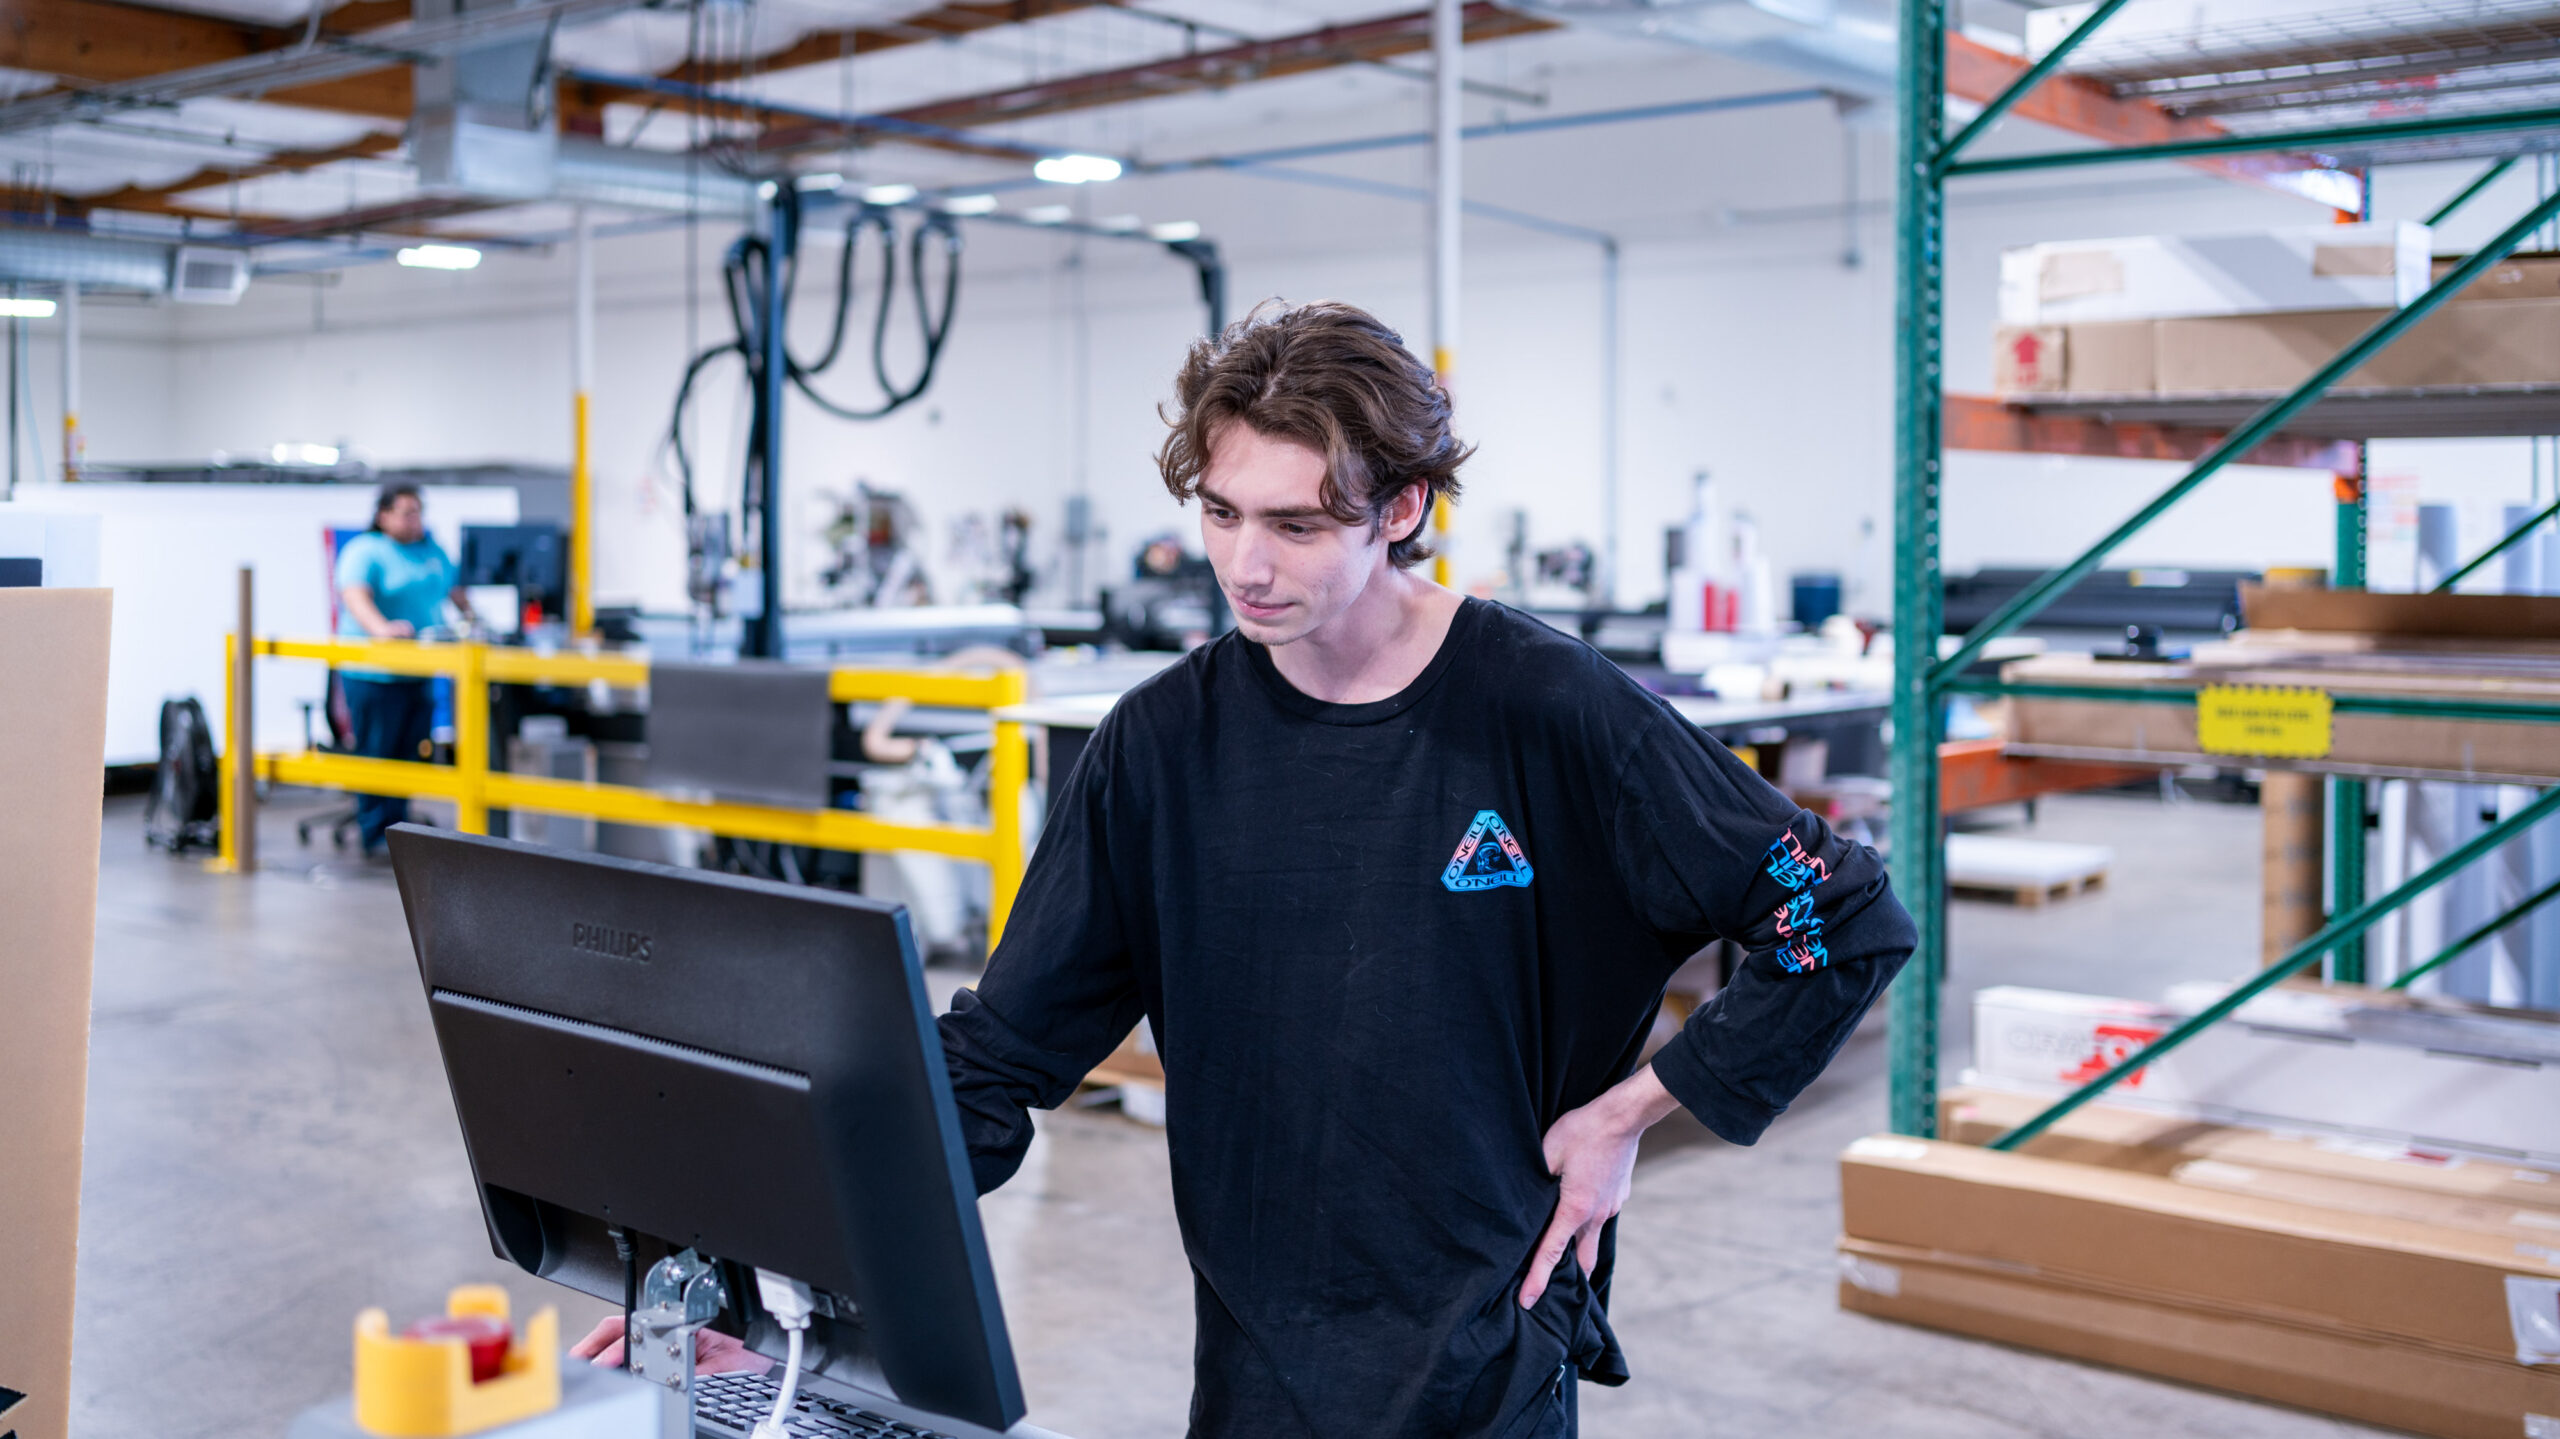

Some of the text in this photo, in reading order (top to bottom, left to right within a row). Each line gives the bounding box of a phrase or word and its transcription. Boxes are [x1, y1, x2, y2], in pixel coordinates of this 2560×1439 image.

[1448, 816, 1489, 880] O'NEILL
[1488, 815, 1529, 878] O'NEILL
[1455, 873, 1525, 888] O'NEILL
[573, 922, 652, 962] PHILIPS
